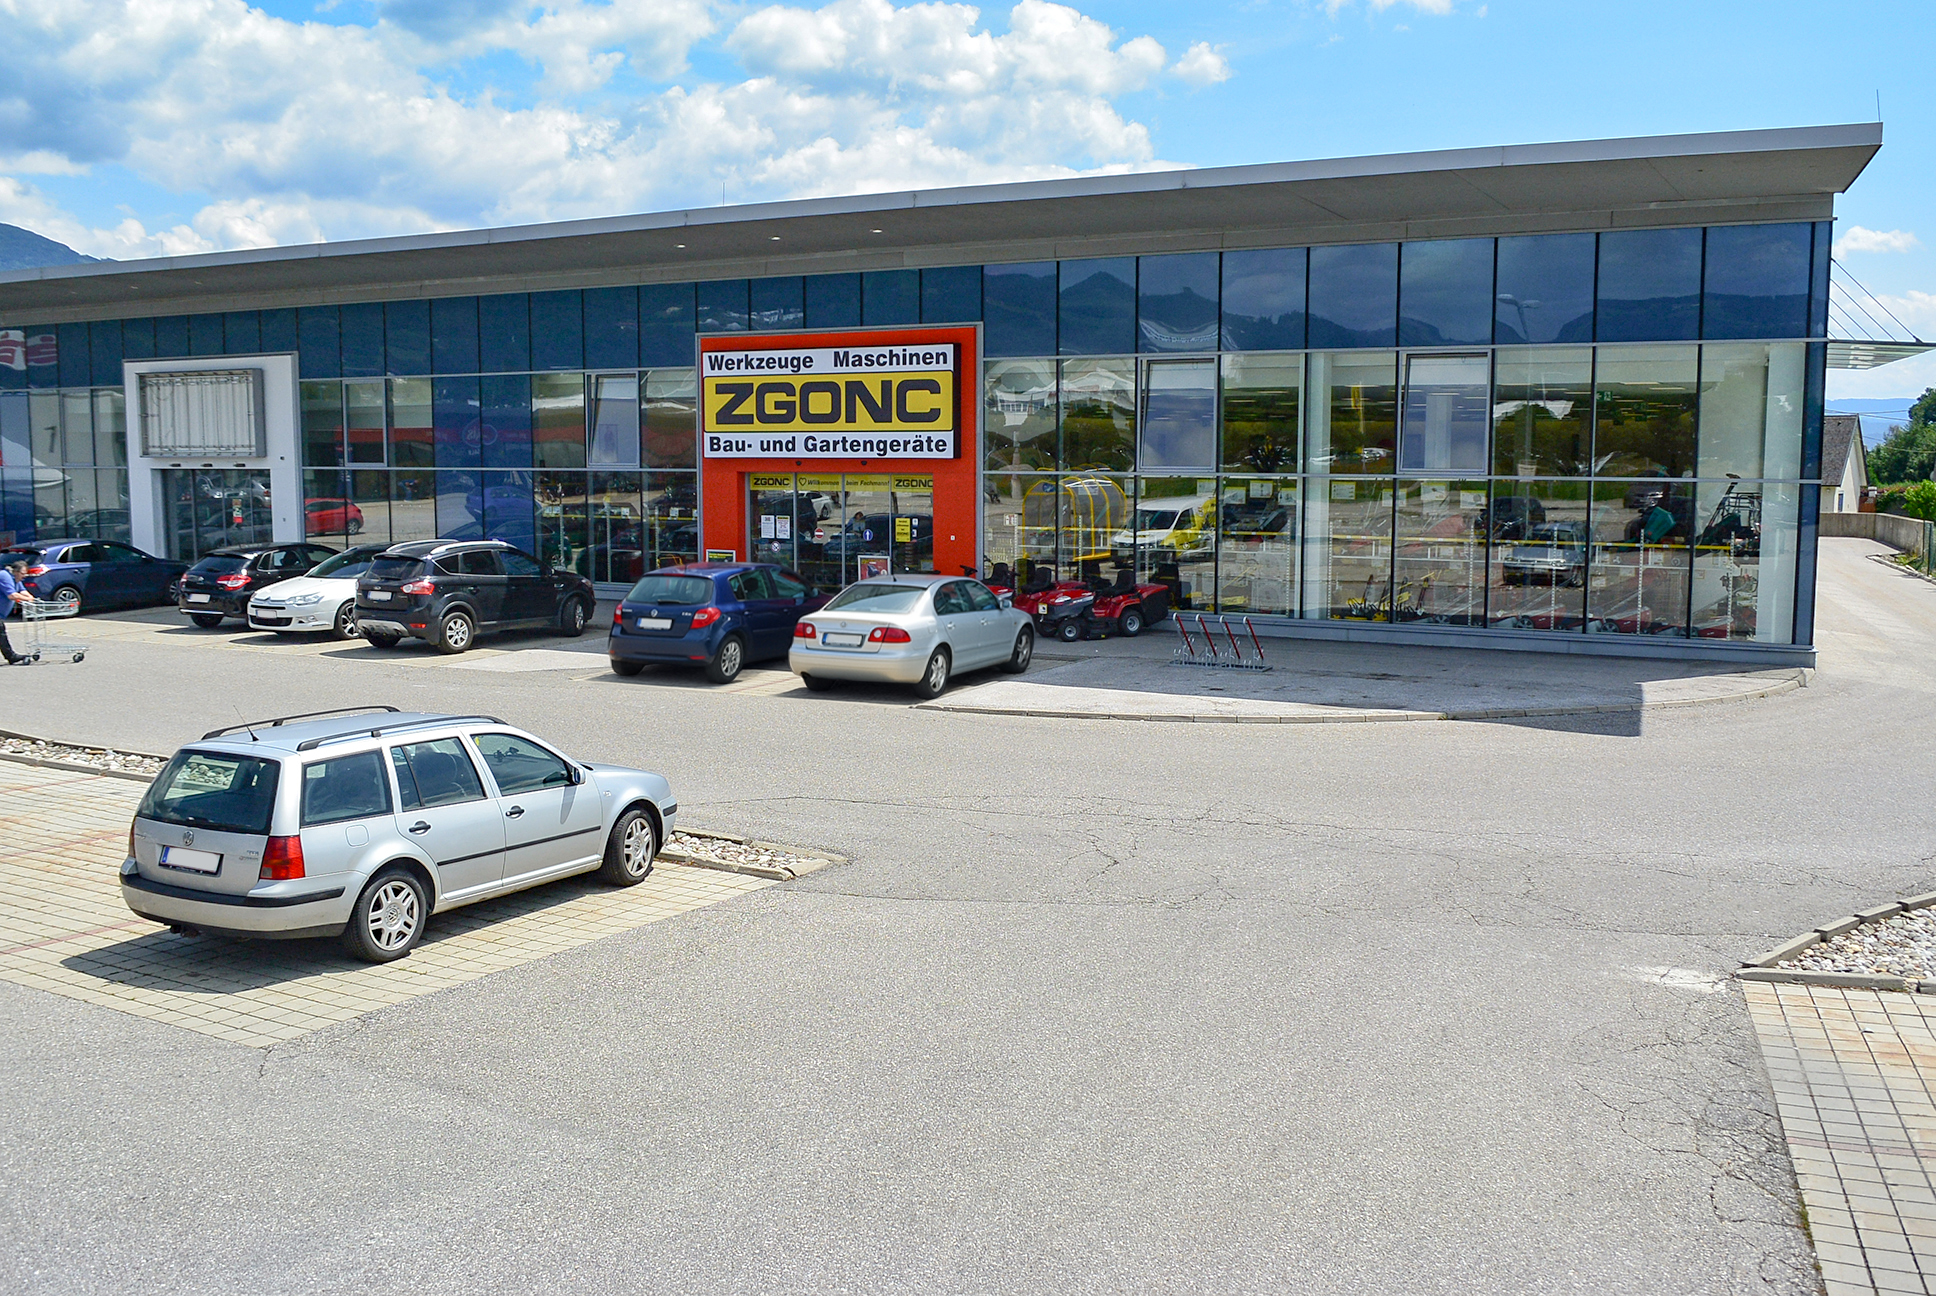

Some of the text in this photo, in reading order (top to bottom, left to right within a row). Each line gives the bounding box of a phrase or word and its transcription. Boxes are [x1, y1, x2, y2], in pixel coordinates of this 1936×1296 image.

[708, 348, 948, 373] Werkzeuge Maschinen
[715, 379, 941, 424] ZGONC
[709, 435, 948, 457] Bau- und Gartengeräte
[753, 477, 790, 486] ZGONC
